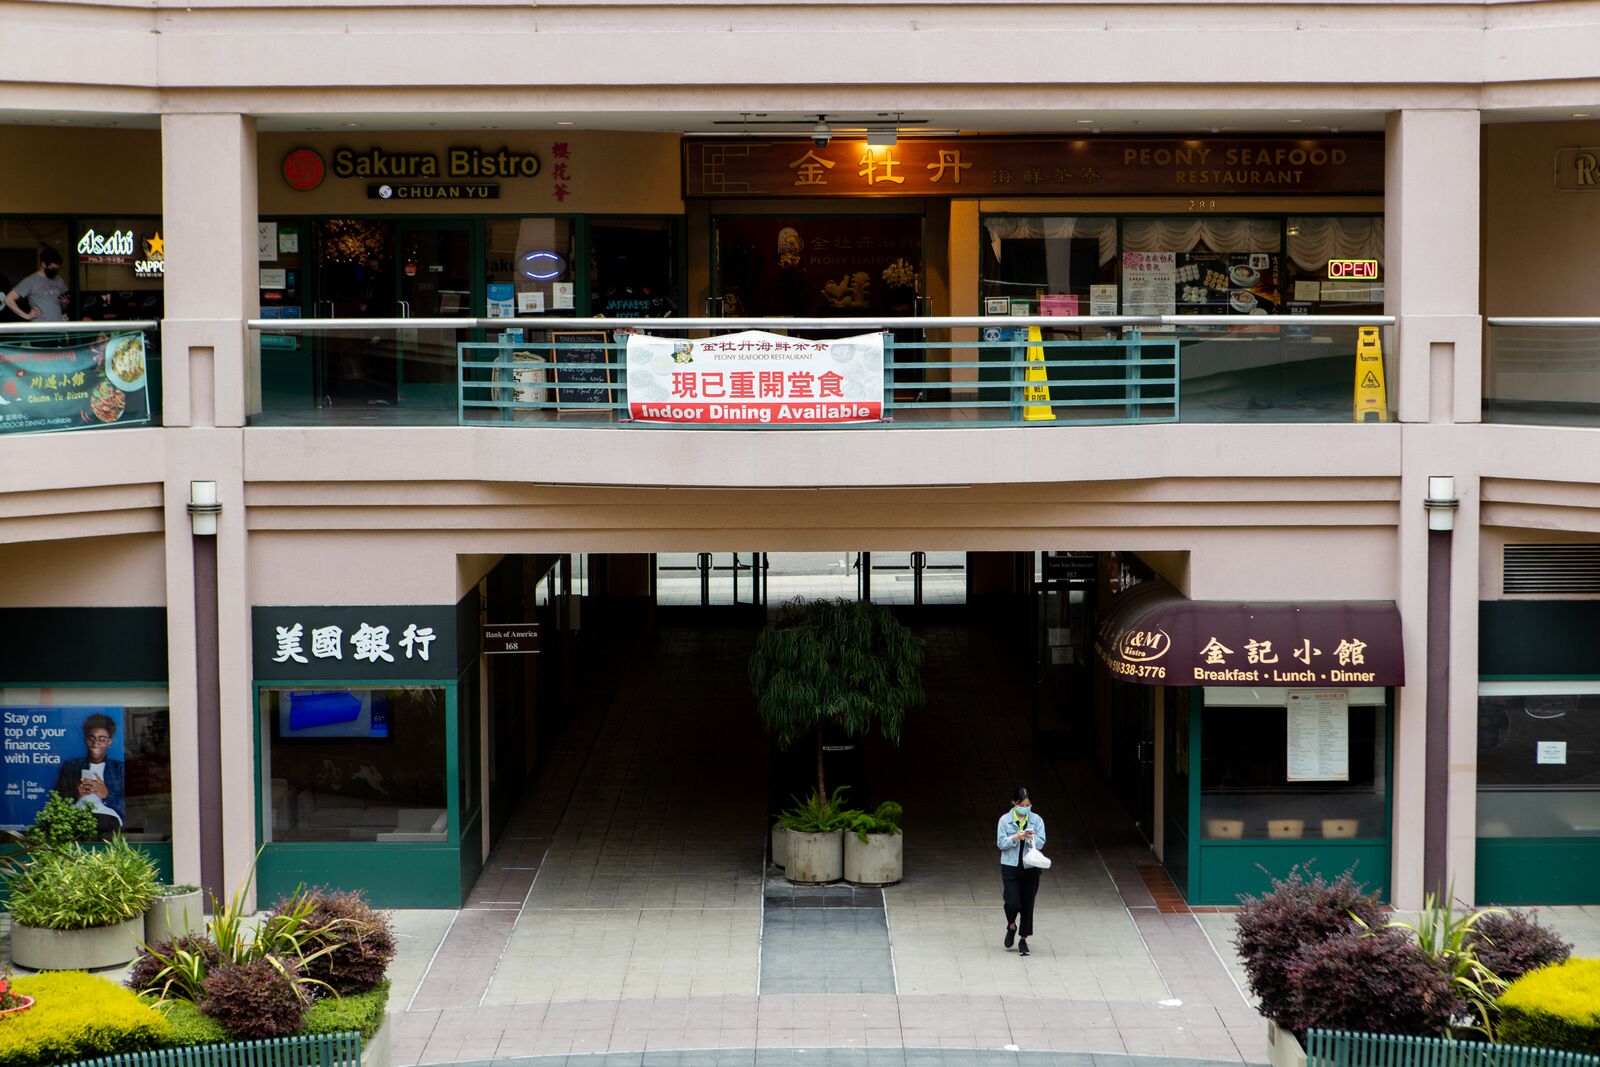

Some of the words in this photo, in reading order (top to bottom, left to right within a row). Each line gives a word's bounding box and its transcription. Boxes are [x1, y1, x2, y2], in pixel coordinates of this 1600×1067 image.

[335, 148, 438, 177] Sakura
[449, 148, 541, 177] Bistro
[1123, 148, 1211, 165] PEONY
[1226, 148, 1347, 166] SEAFOOD
[789, 149, 974, 187] 金牡丹
[1176, 170, 1303, 183] RESTAURANT
[398, 186, 460, 198] CHUAN
[466, 186, 489, 198] YU
[1189, 200, 1216, 211] 288
[78, 229, 133, 255] Asahi
[1331, 262, 1375, 277] OPEN
[0, 352, 27, 363] rand
[671, 371, 845, 399] 現已重開堂食
[28, 394, 51, 403] Chuan
[66, 391, 89, 400] Bistro
[641, 403, 704, 420] Indoor
[715, 403, 773, 422] Dining
[777, 403, 870, 420] Available
[511, 630, 538, 638] America
[271, 623, 437, 663] 美國銀行
[505, 642, 519, 650] 168
[1124, 646, 1146, 657] Bistro
[1200, 637, 1368, 666] 金記小館
[1193, 668, 1259, 681] Breakfast
[1273, 669, 1316, 682] Lunch
[1331, 669, 1376, 682] Dinner
[4, 712, 29, 725] Stay
[32, 715, 47, 724] on
[4, 727, 23, 739] top
[26, 727, 38, 737] of
[41, 728, 67, 739] your
[4, 739, 50, 751] finances
[4, 752, 30, 764] with
[33, 752, 61, 764] Erica
